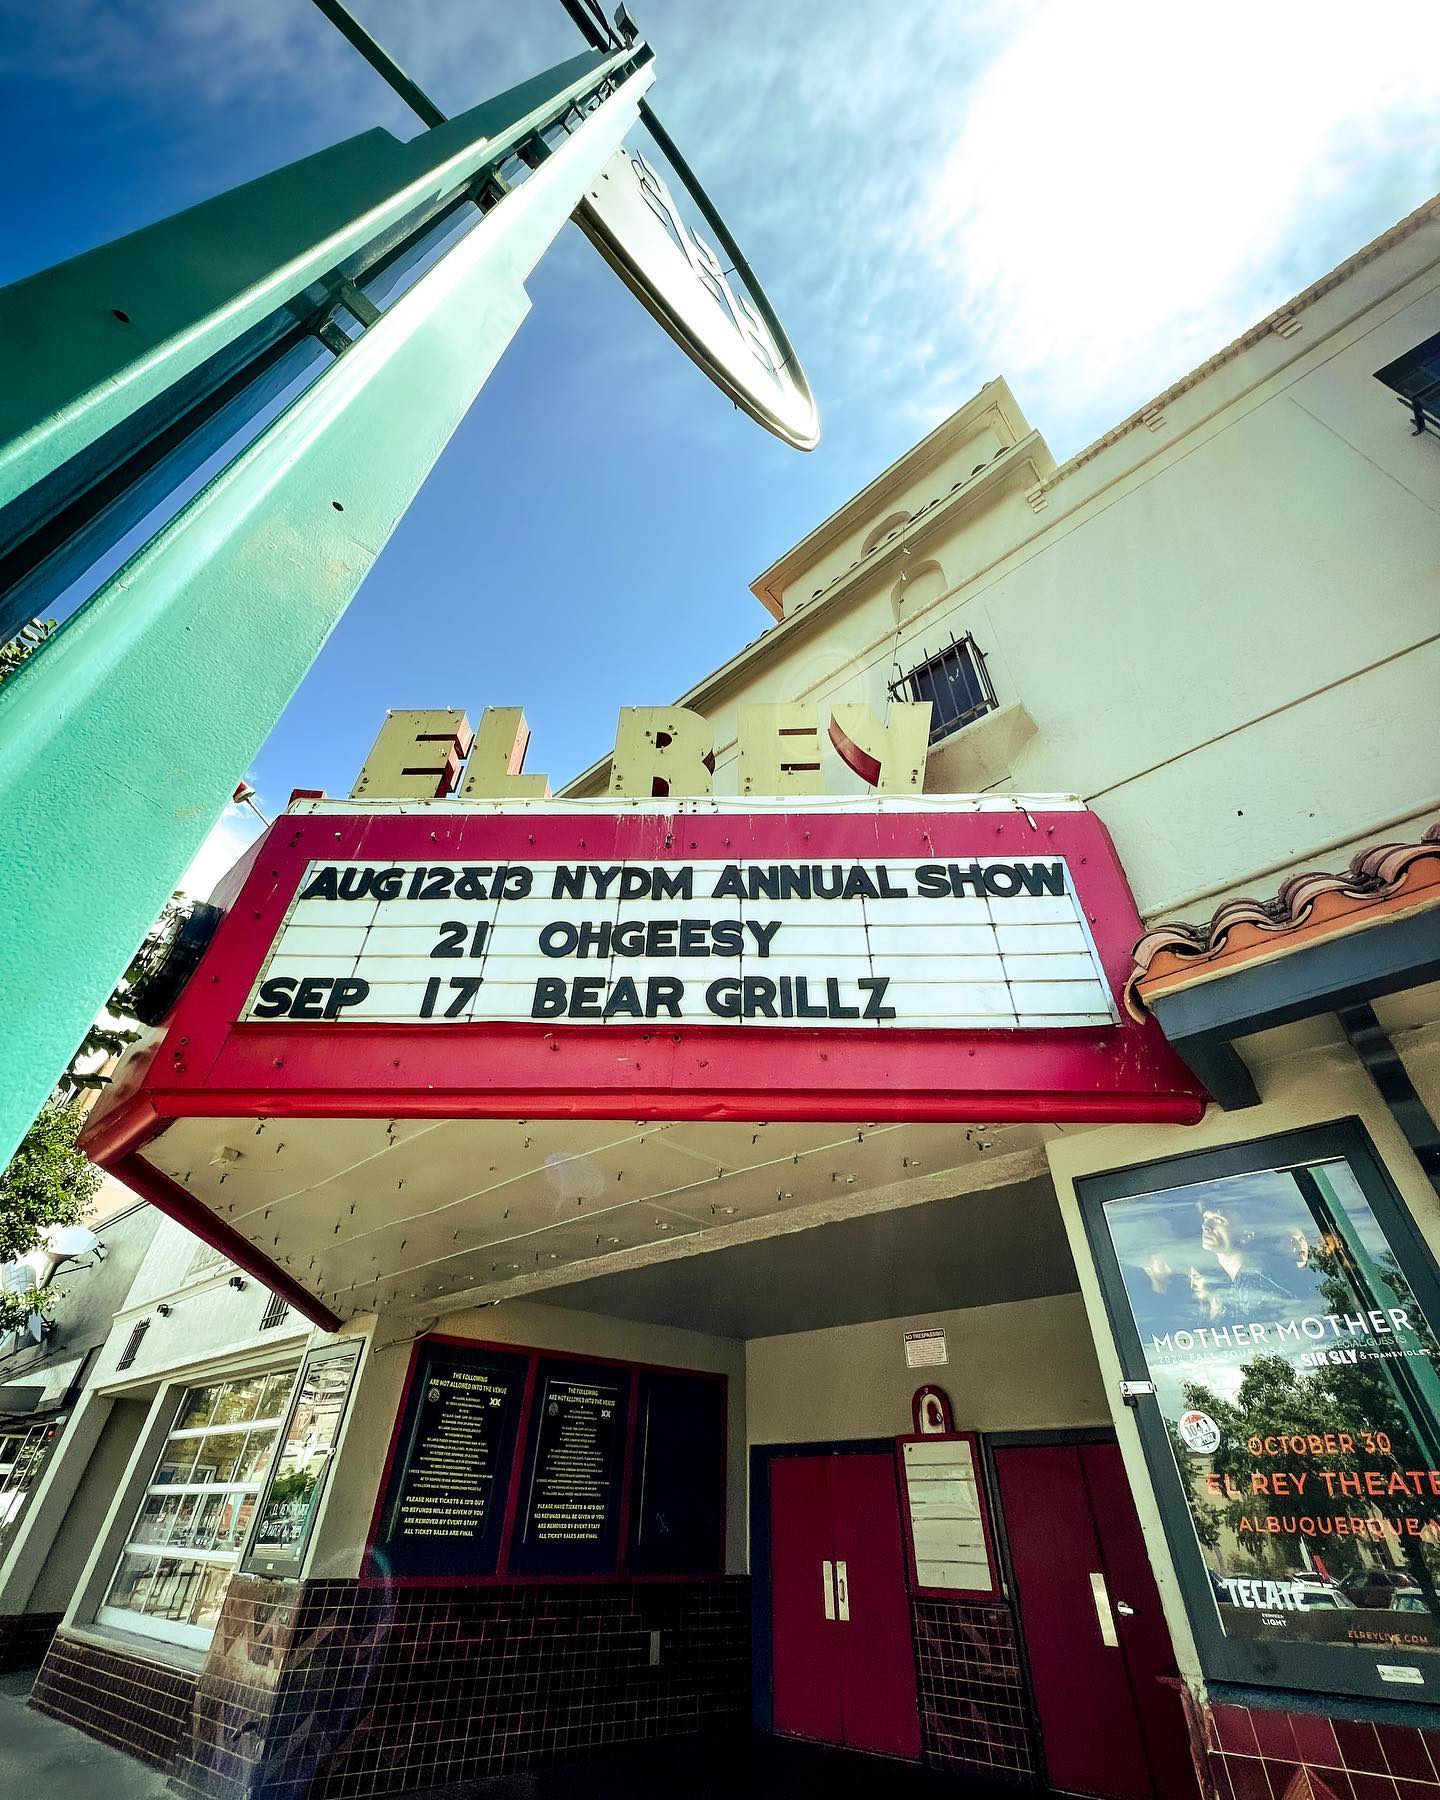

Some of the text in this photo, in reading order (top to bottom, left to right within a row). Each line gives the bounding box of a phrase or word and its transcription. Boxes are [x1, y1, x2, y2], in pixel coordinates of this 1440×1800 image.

[350, 702, 932, 798] EL REY
[301, 863, 1065, 901] AUG 12&13 NYDM ANNUAL SHOW
[430, 920, 782, 958] 21 OHGEESY
[253, 976, 896, 1019] SEP 17 BEAR GRILLZ
[1151, 1308, 1414, 1353] MOTHER MOTHER
[1366, 1335, 1407, 1347] GUESTS
[1224, 1348, 1255, 1359] TOUR
[1301, 1348, 1431, 1367] SIR SLY & TRANSVIOLET
[429, 1378, 439, 1386] ARE
[440, 1380, 450, 1388] NOT
[450, 1382, 472, 1390] ALLOWED
[483, 1385, 493, 1393] THE
[452, 1372, 489, 1383] THE FOLLOWING
[1248, 1431, 1392, 1457] OCTOBER 30
[1205, 1473, 1241, 1497] EL
[1251, 1472, 1308, 1497] REY
[1239, 1515, 1421, 1539] ALBUQUERQUE
[1222, 1578, 1310, 1612] TECATE
[1262, 1618, 1287, 1627] LIGHT
